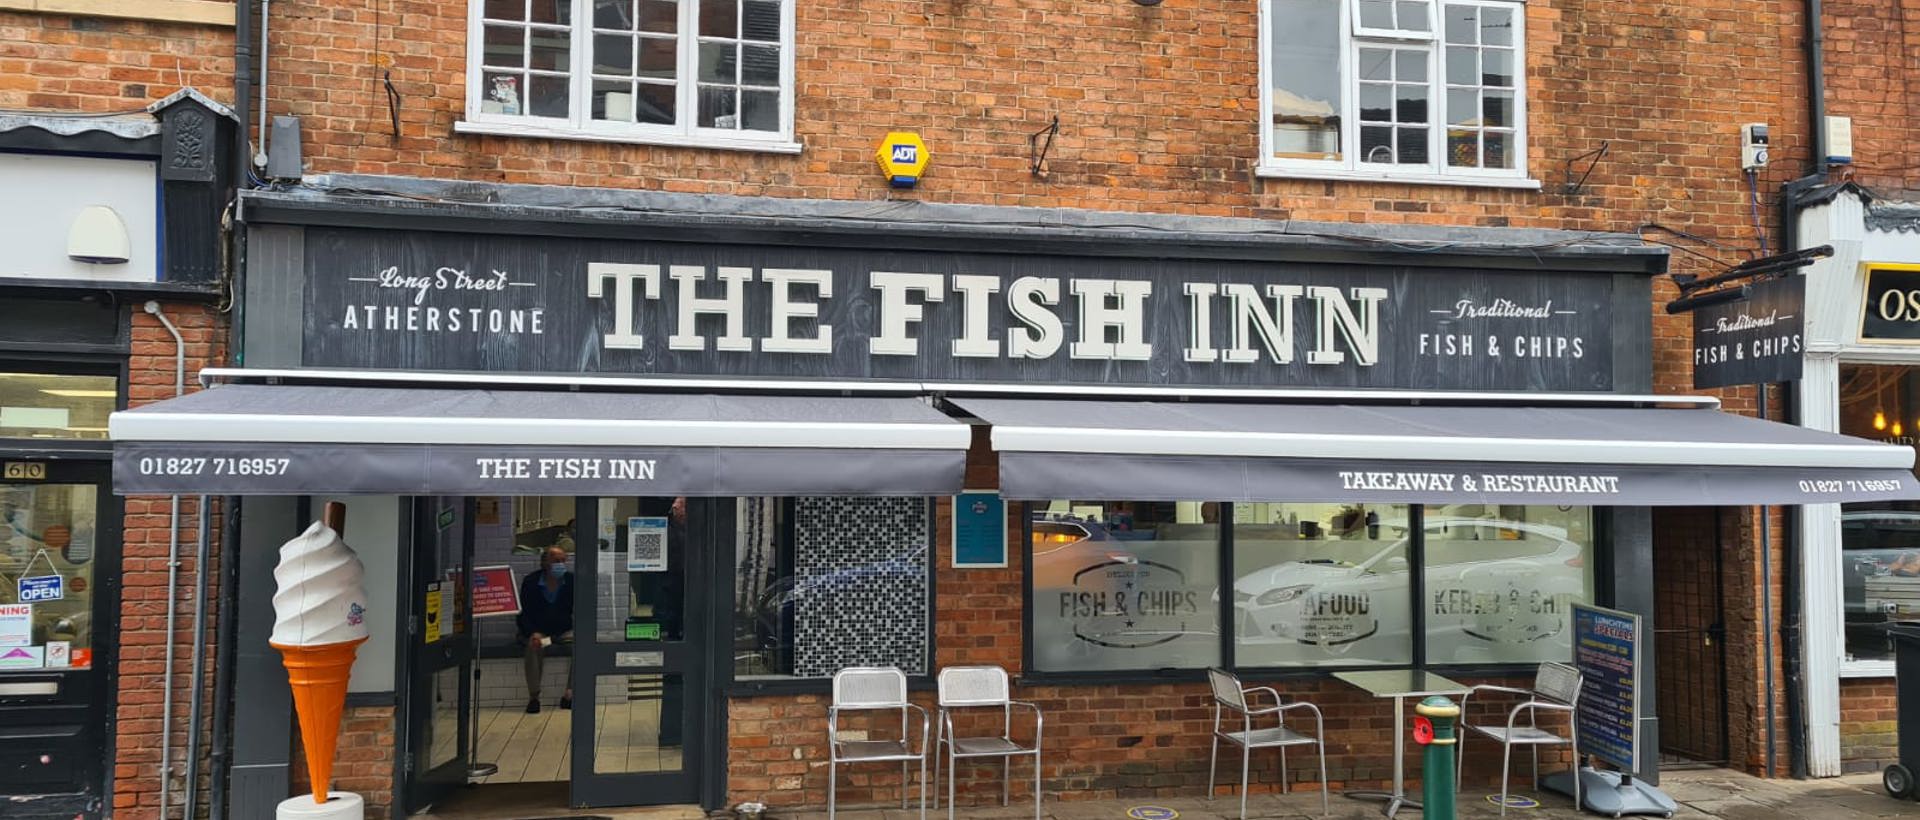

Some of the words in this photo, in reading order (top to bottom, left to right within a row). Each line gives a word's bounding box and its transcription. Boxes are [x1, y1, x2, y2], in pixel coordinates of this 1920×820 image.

[892, 147, 917, 161] ADT
[379, 266, 431, 305] Long
[435, 267, 508, 290] Street
[343, 305, 544, 335] ATHERSTONE
[587, 262, 833, 353] THE
[869, 272, 1153, 361] FISH
[1183, 282, 1388, 366] INN
[1455, 298, 1552, 319] Traditional
[1716, 309, 1777, 335] Traditional
[1420, 334, 1473, 356] FISH
[1488, 336, 1500, 356] &
[1515, 336, 1583, 359] CHIPS
[1695, 345, 1728, 366] FISH
[1735, 342, 1745, 361] &
[1752, 335, 1800, 359] CHIPS
[140, 458, 207, 475] 01827
[213, 458, 290, 475] 716957
[476, 458, 531, 479] THE
[538, 458, 602, 479] FISH
[608, 459, 657, 480] INN
[1339, 472, 1455, 491] TAKEAWAY
[1462, 475, 1478, 492] &
[1482, 474, 1619, 493] RESTAURANT
[1799, 479, 1843, 493] 01827
[1847, 479, 1902, 492] 716957
[21, 586, 60, 600] OPEN
[1060, 591, 1106, 617] FISH
[1115, 591, 1129, 616] &
[1137, 590, 1197, 617] CHIPS
[1303, 591, 1370, 617] AFOOD
